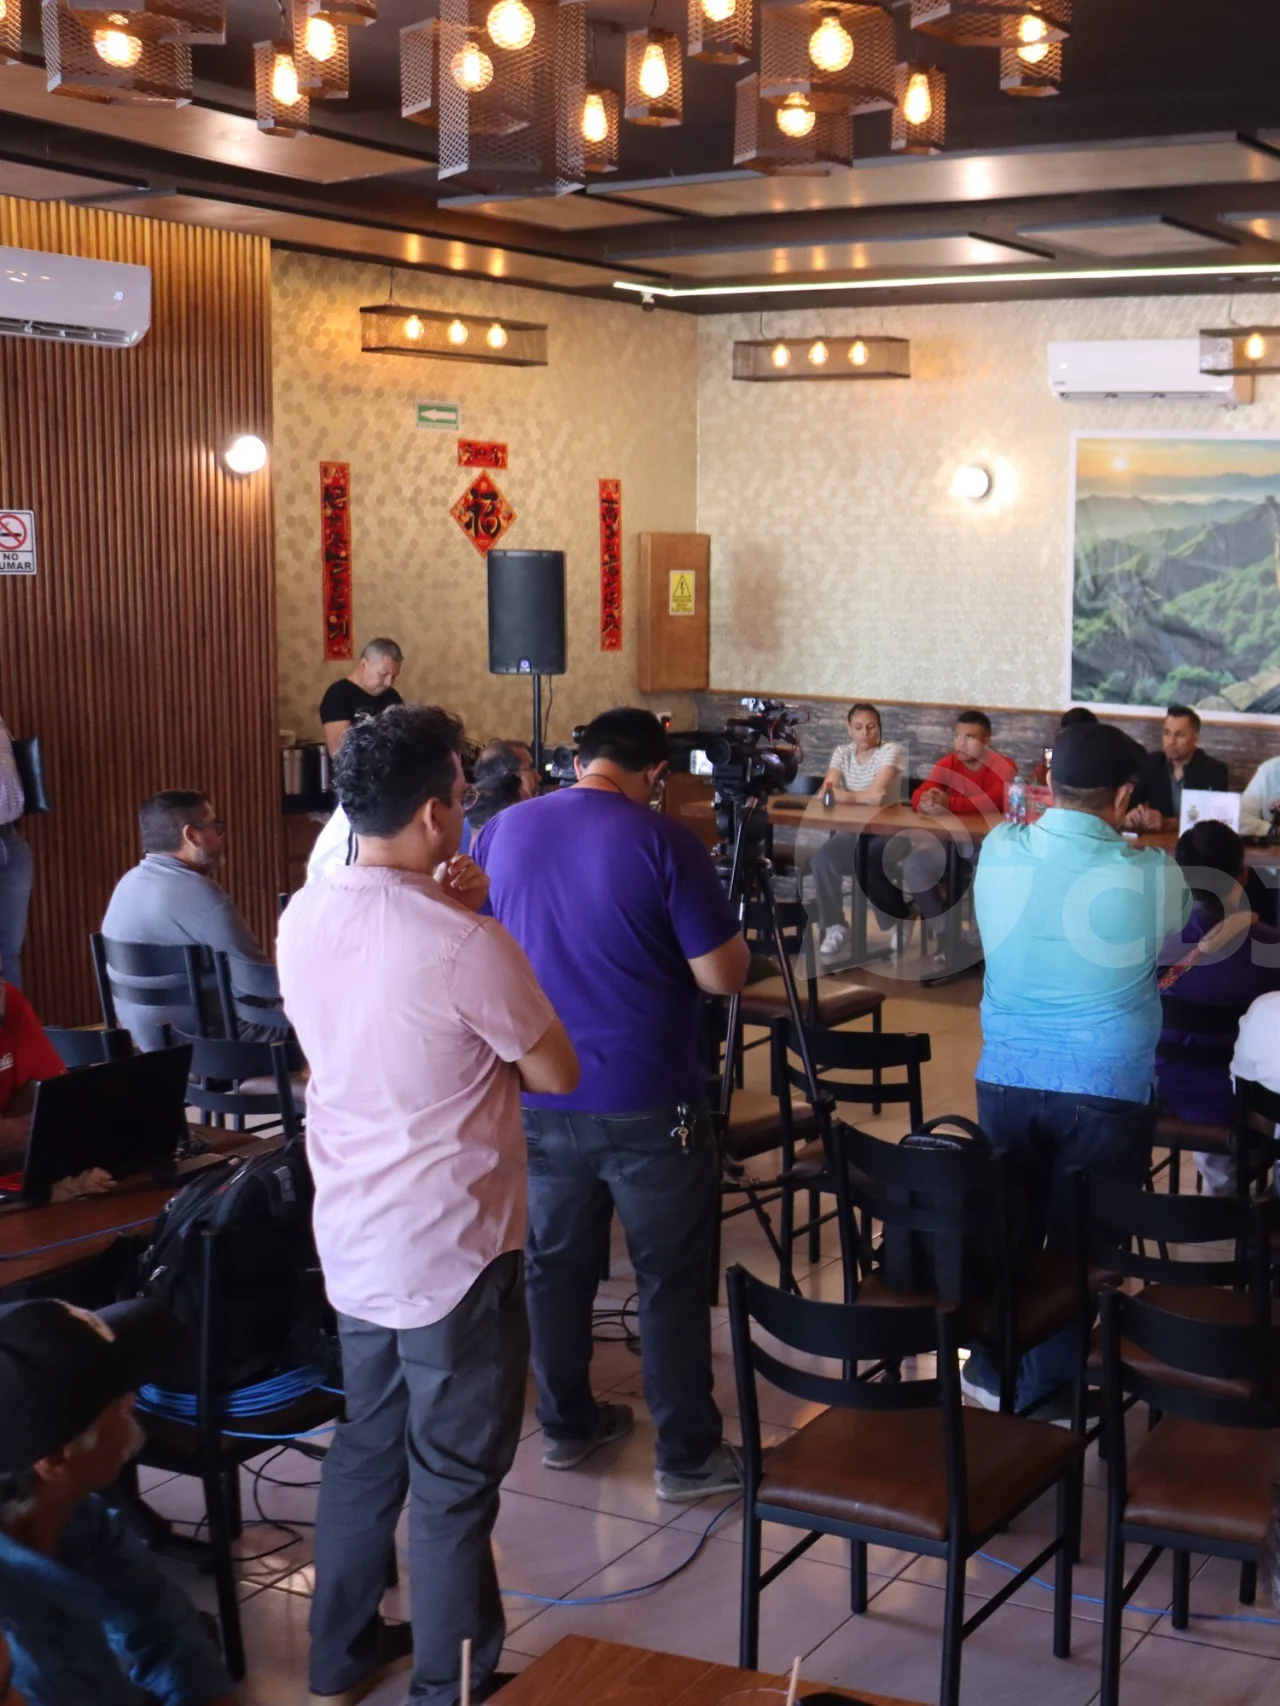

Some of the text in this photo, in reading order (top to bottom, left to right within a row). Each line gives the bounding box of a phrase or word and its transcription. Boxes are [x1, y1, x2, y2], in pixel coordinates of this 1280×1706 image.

[464, 487, 502, 538] 福
[3, 553, 19, 561] NO
[0, 561, 32, 570] UMAR
